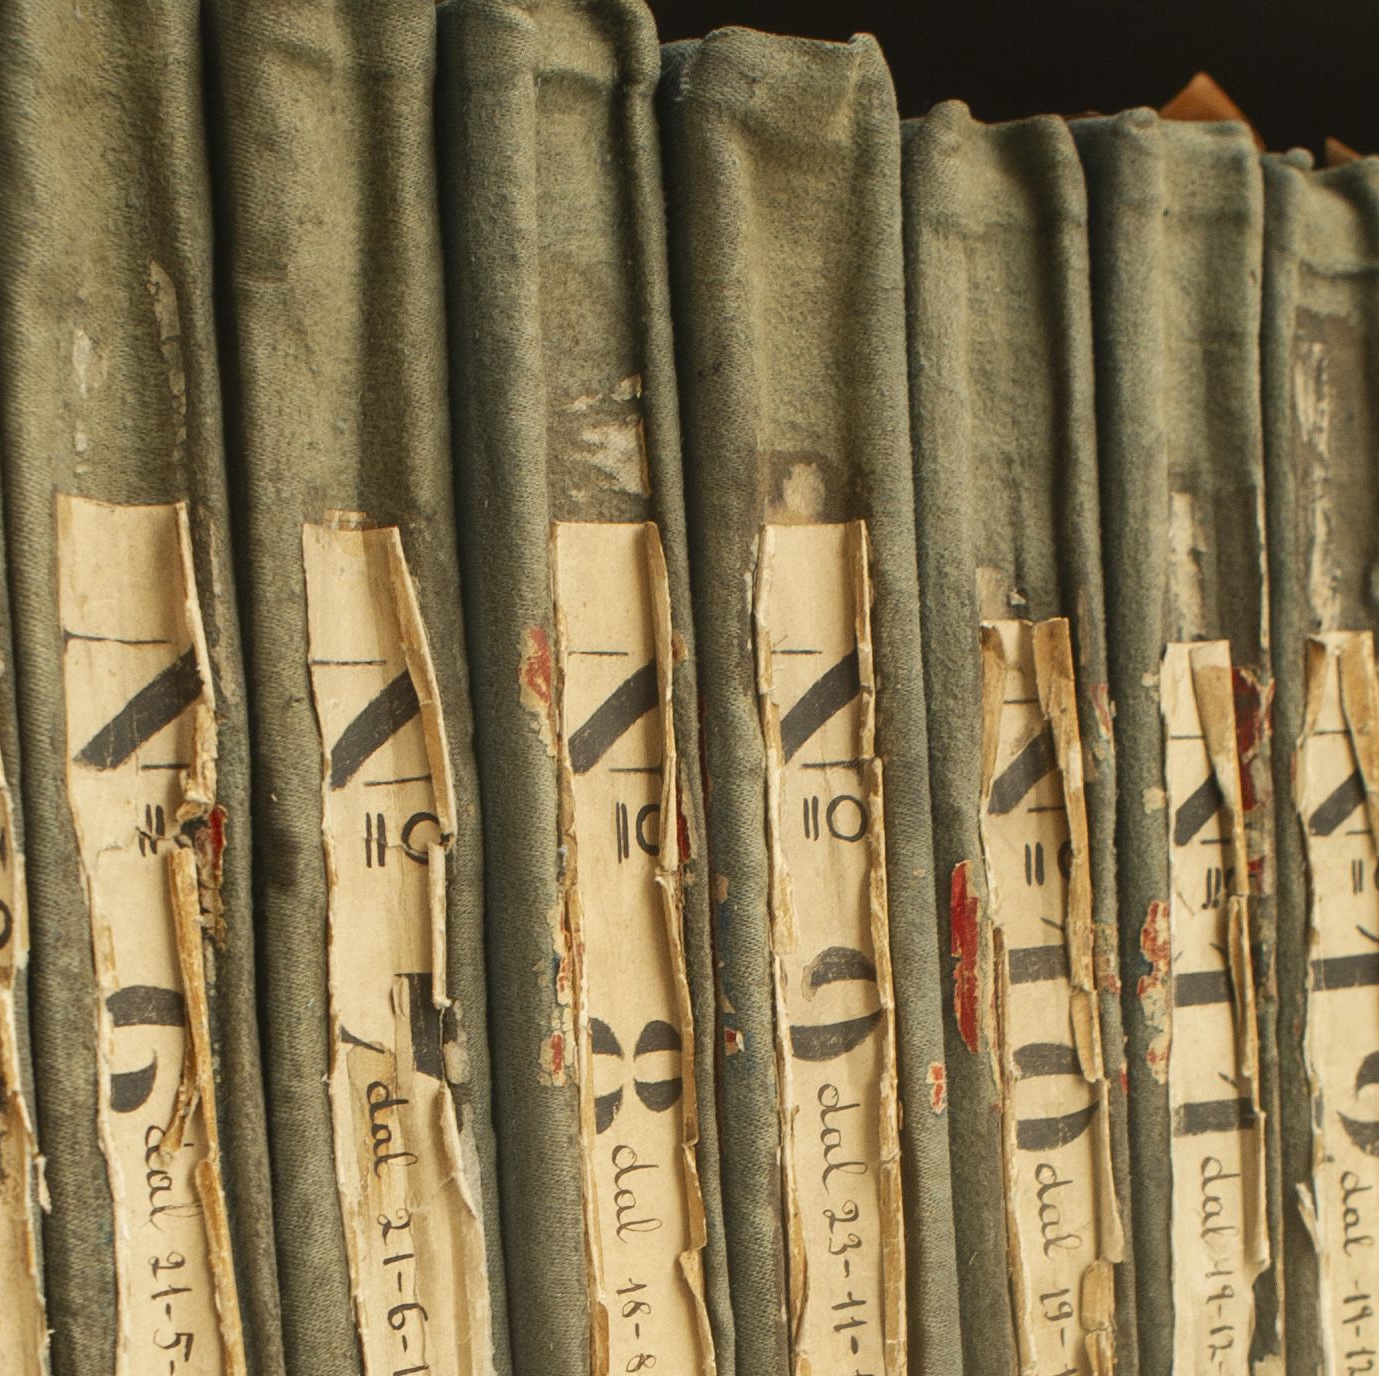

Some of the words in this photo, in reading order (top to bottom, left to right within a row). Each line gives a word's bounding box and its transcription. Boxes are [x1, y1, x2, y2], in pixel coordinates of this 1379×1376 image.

[789, 946, 885, 1062] 9
[1006, 918, 1098, 1152] 10
[587, 1017, 683, 1135] 8
[143, 1124, 202, 1229] dal
[366, 1080, 418, 1186] dal
[817, 1082, 867, 1195] dal
[611, 1143, 660, 1246] dal
[1035, 1163, 1081, 1261] dal
[1200, 1157, 1241, 1244] dal
[1340, 1171, 1373, 1257] dal
